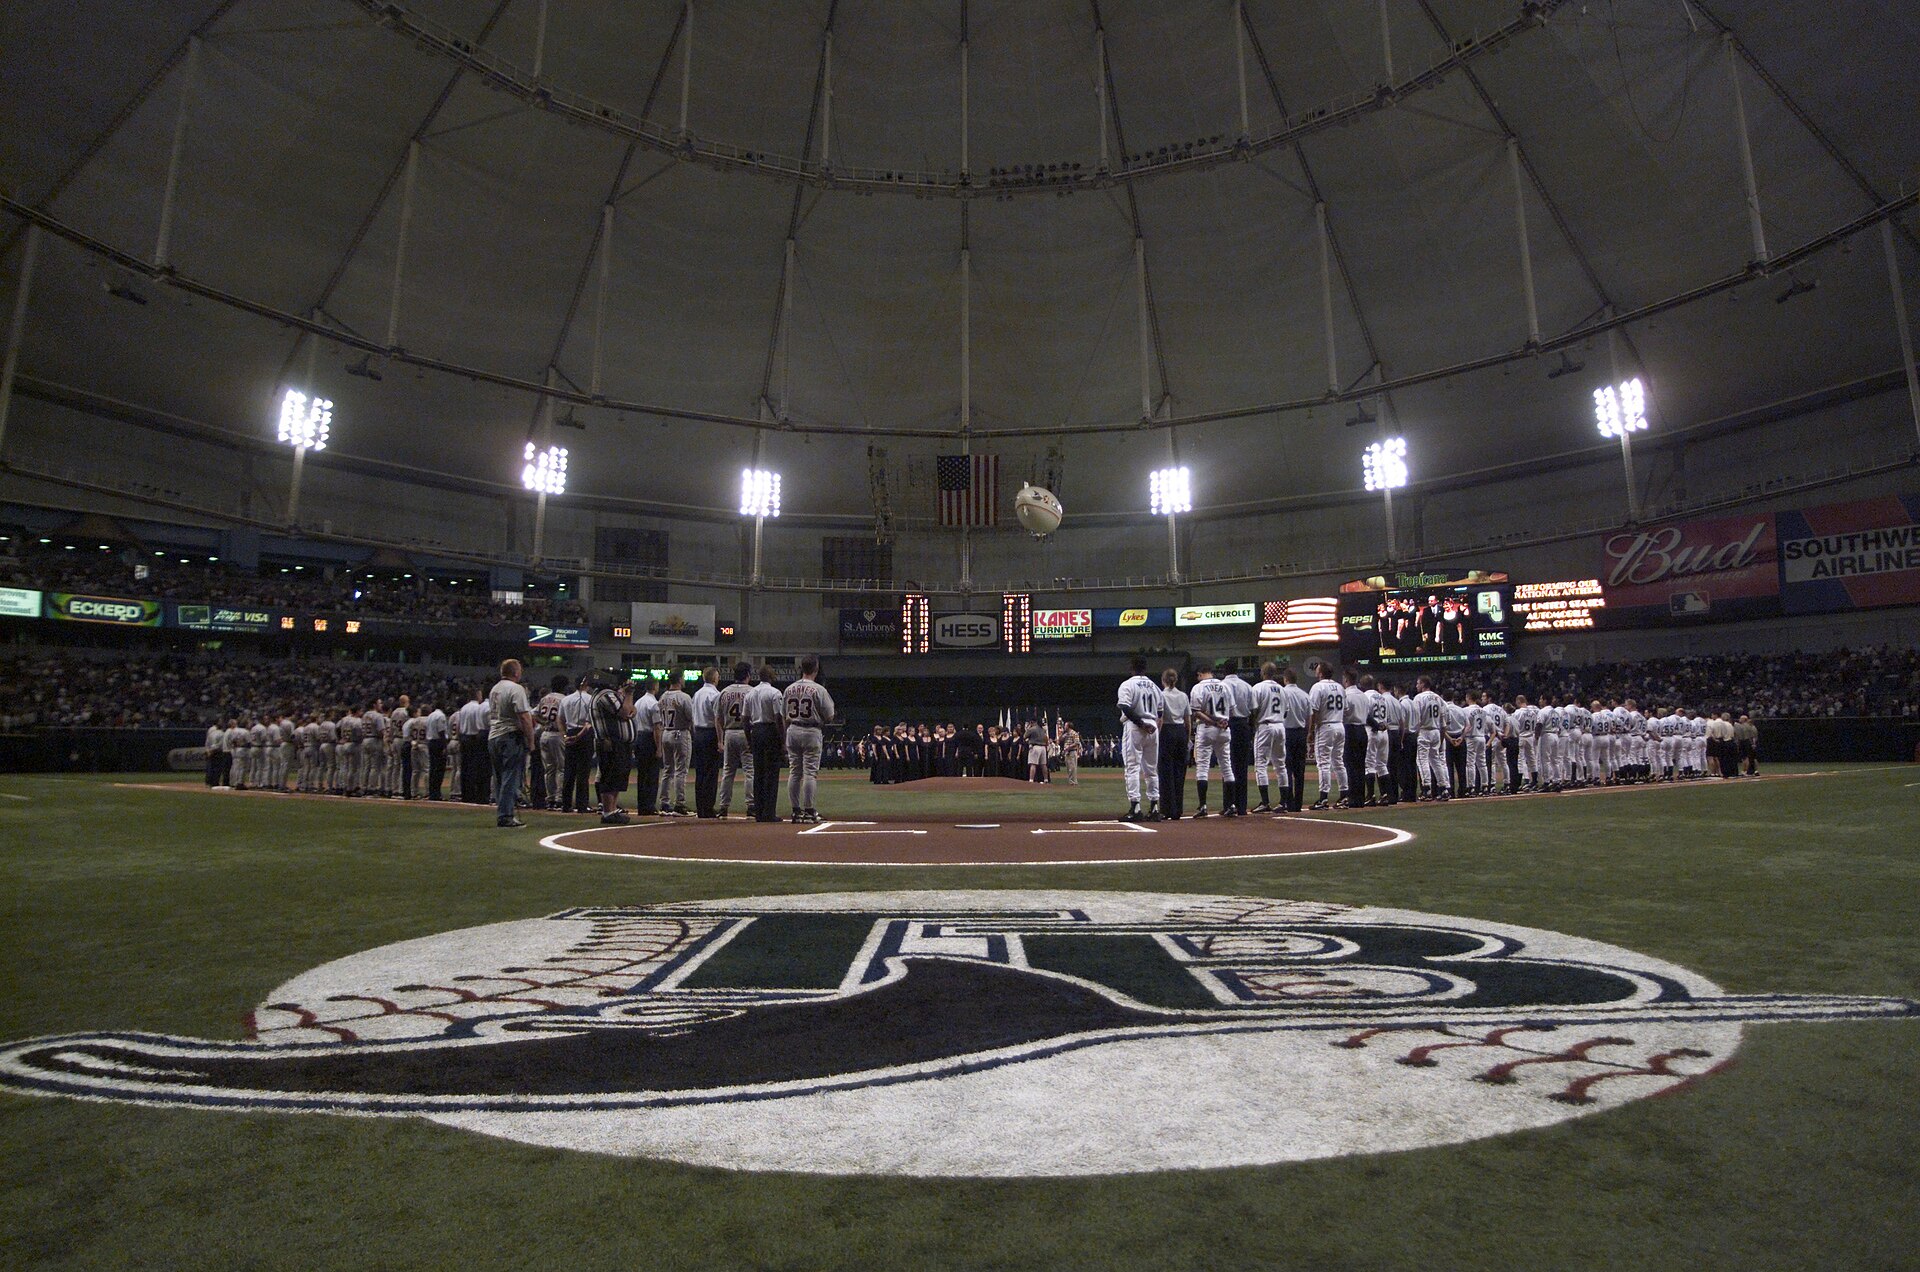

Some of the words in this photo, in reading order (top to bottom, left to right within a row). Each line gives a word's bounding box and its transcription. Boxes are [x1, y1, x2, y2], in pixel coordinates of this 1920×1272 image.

[1606, 523, 1766, 586] Bud
[1811, 549, 1920, 578] AIRLINE
[1395, 571, 1447, 587] Tropicana
[1514, 588, 1560, 599] NATIONAL
[1562, 586, 1602, 596] ANTHEM
[1515, 581, 1576, 592] PERFORMING
[1578, 580, 1598, 588] OUR
[70, 601, 140, 620] ECKERD
[1512, 603, 1530, 611] THE
[1532, 601, 1567, 610] UNITED
[1569, 598, 1605, 608] STATES
[244, 612, 269, 623] VISA
[1034, 611, 1090, 626] KANE'S
[1122, 613, 1145, 623] Lykes
[1205, 609, 1251, 619] CHEVROLET
[1342, 615, 1373, 624] PEPSI
[1526, 609, 1590, 620] AUTOMOBILE
[856, 622, 895, 632] Anthony's
[1553, 618, 1594, 628] CHORUS
[941, 623, 991, 638] HESS
[1034, 626, 1091, 634] FURNITURE
[1479, 632, 1504, 640] KMC
[788, 685, 816, 696] GARNER
[788, 698, 812, 719] 33
[1142, 693, 1152, 713] 11
[1208, 696, 1226, 716] 14
[1271, 697, 1281, 714] 2
[1327, 694, 1343, 711] 28
[540, 706, 558, 722] 26
[729, 702, 741, 722] 4
[1373, 703, 1386, 719] 23
[1428, 704, 1439, 718] 18
[662, 709, 676, 727] 17
[1476, 718, 1482, 730] 3
[1495, 715, 1500, 726] 9
[1524, 719, 1535, 731] 61
[1597, 722, 1609, 732] 38
